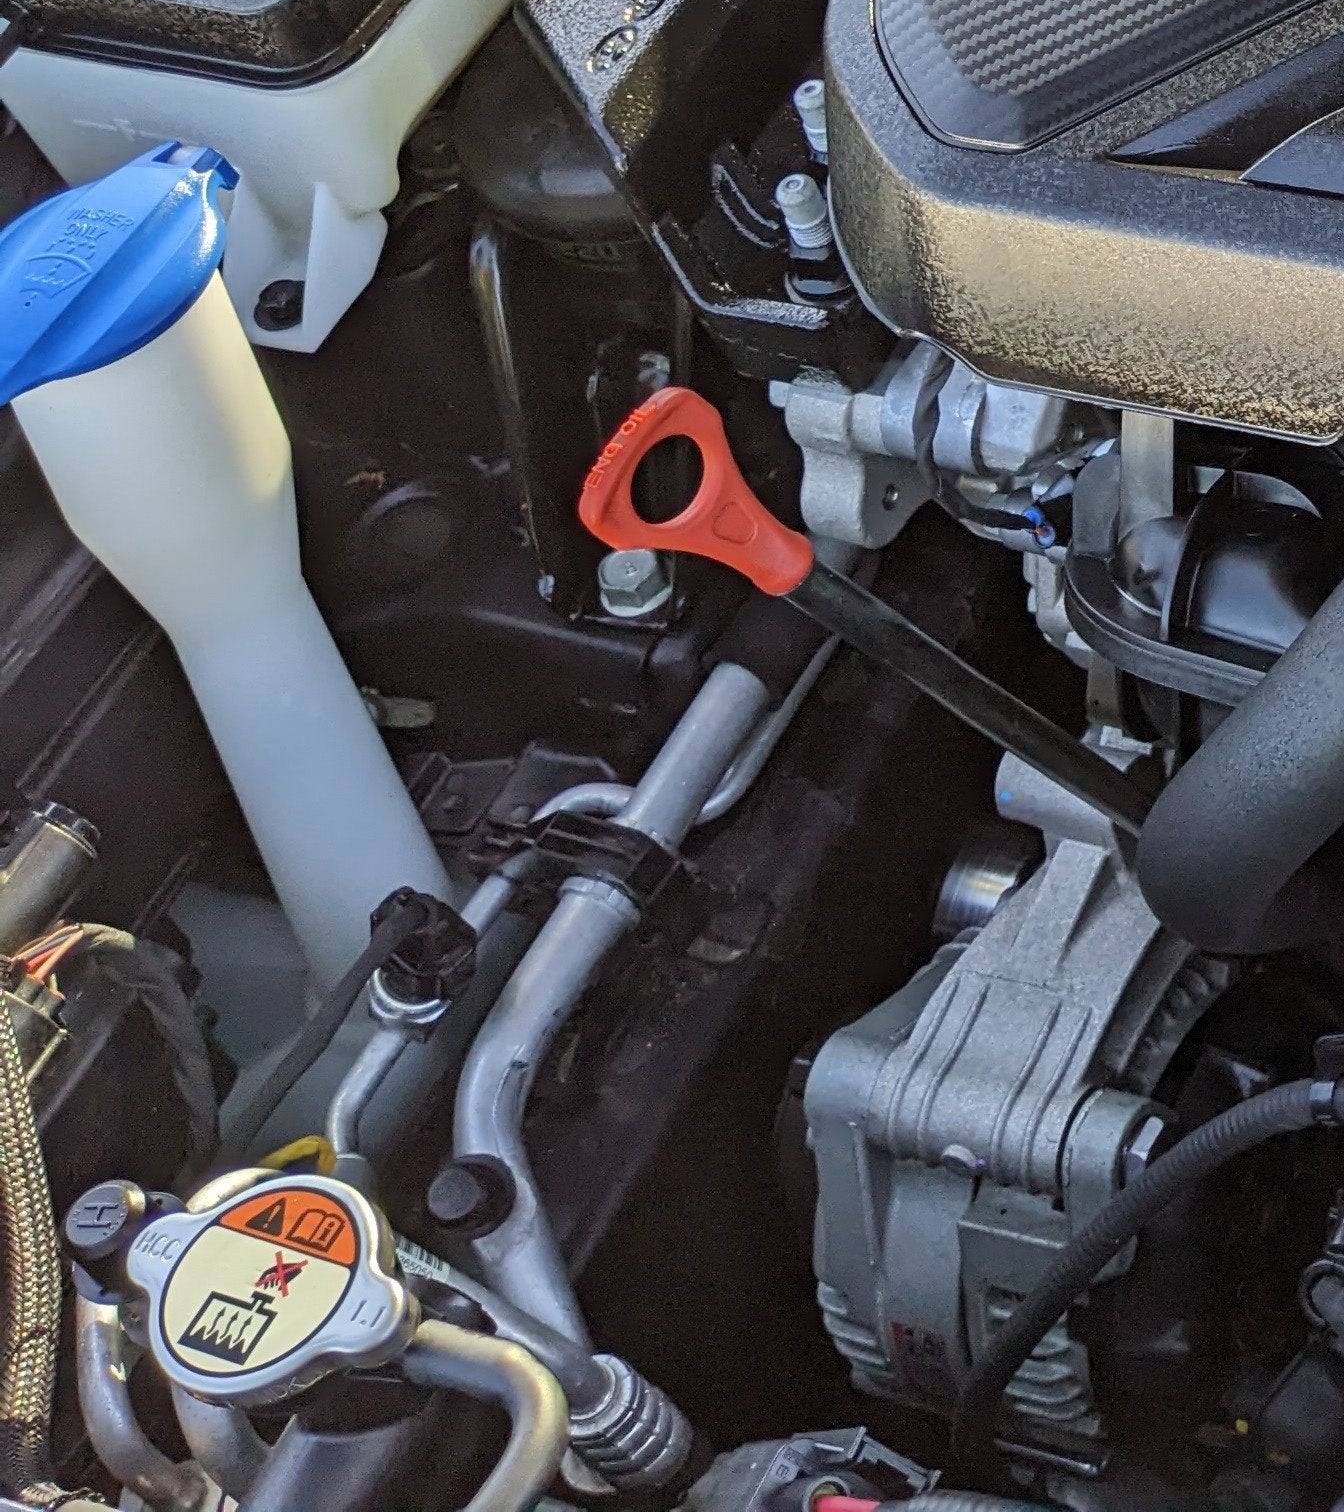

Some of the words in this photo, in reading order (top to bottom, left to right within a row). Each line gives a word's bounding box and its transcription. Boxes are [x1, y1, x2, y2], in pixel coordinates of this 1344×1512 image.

[64, 222, 109, 241] ONLY
[66, 207, 135, 232] WASHER
[583, 441, 623, 489] ENG
[620, 404, 658, 436] OIL
